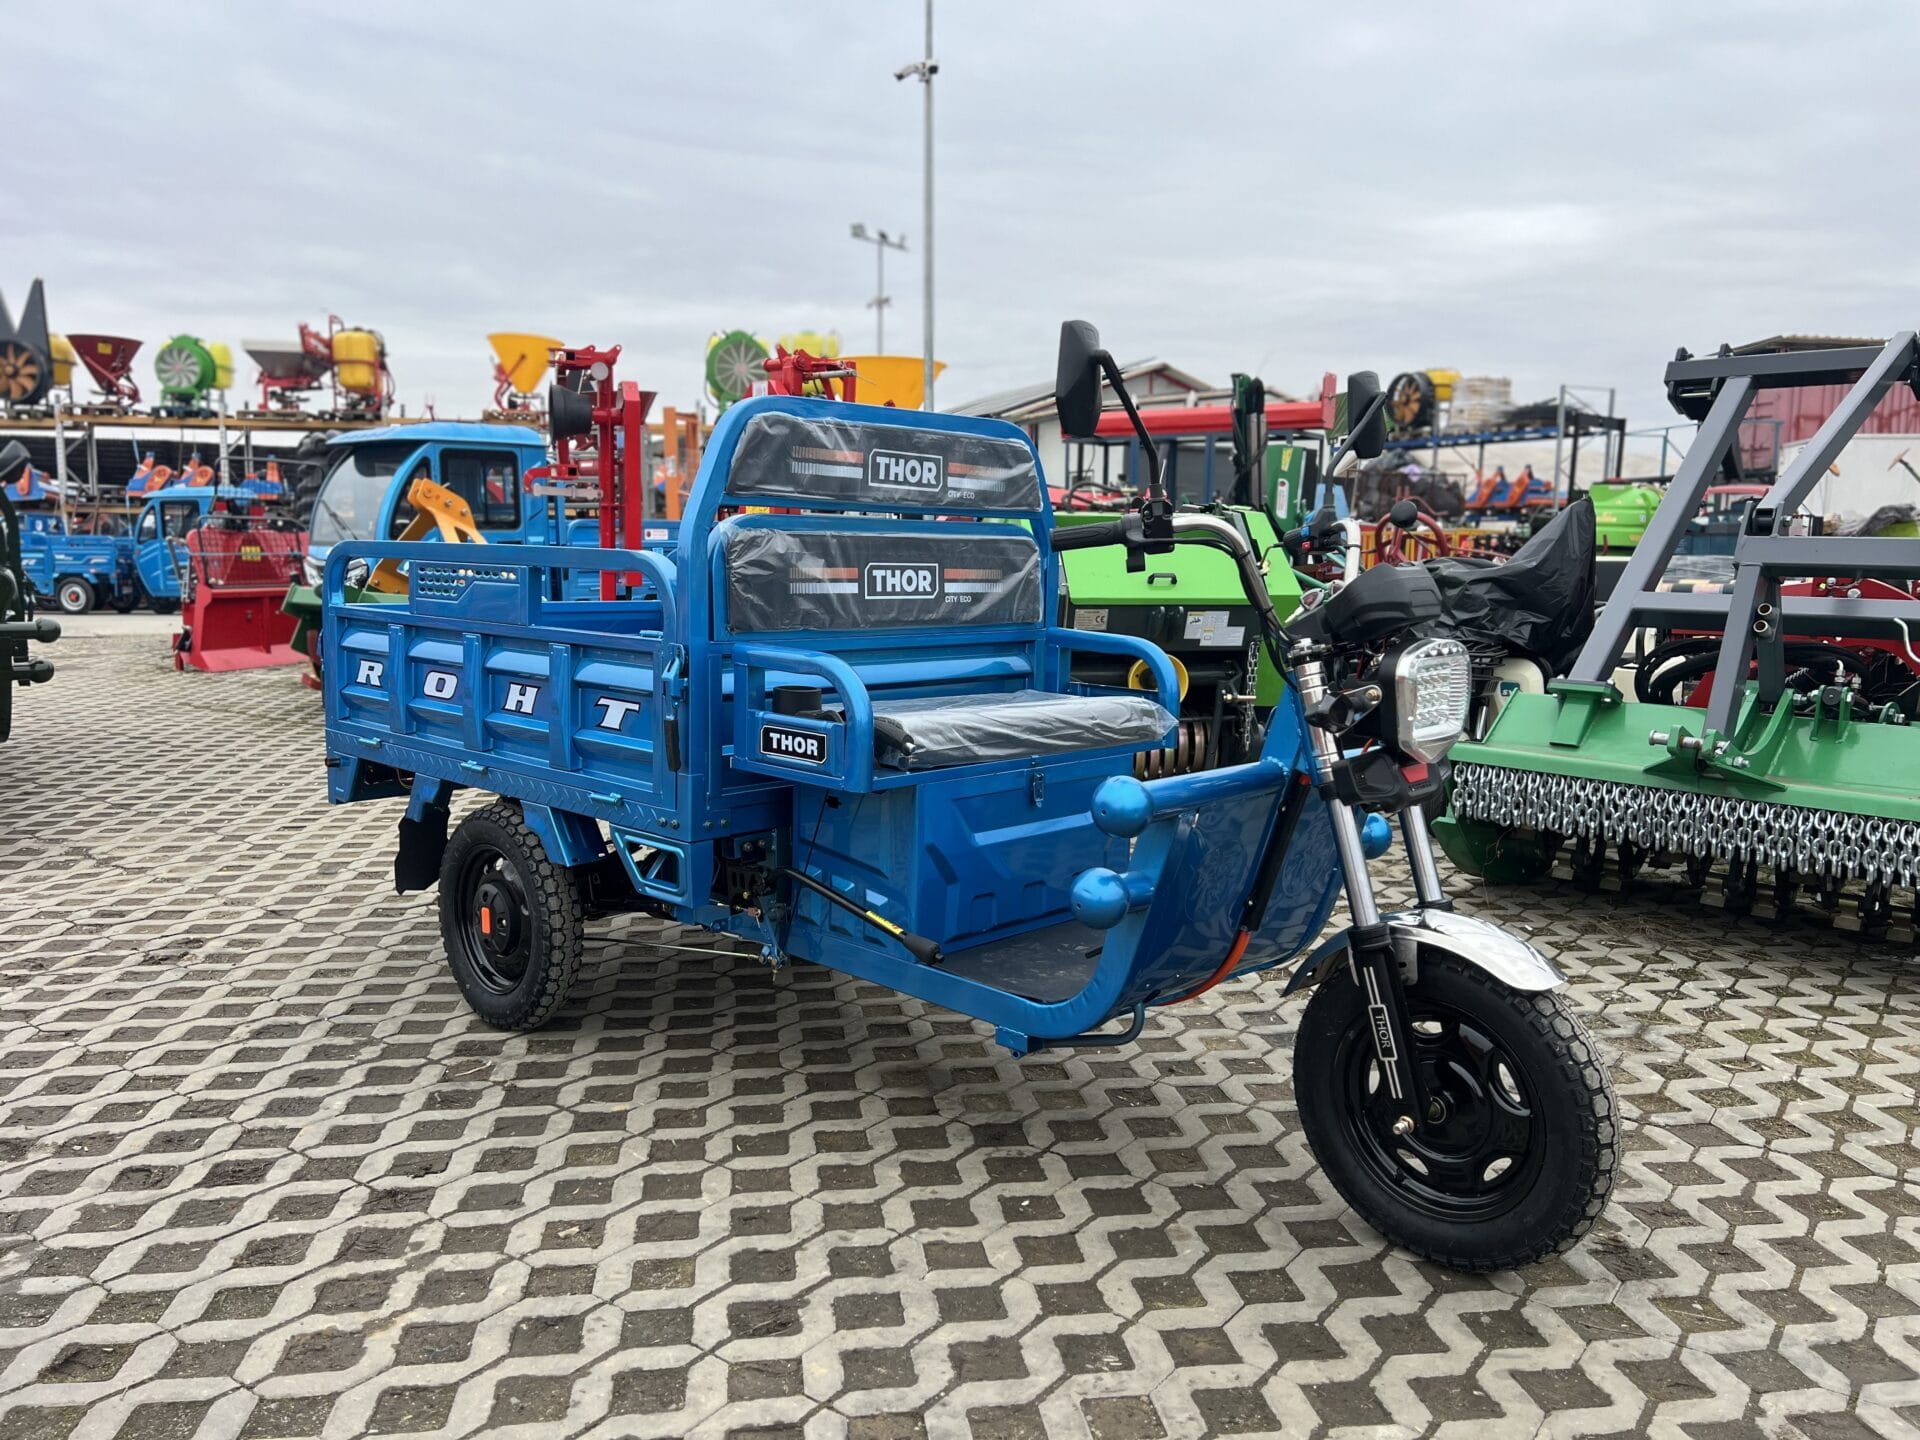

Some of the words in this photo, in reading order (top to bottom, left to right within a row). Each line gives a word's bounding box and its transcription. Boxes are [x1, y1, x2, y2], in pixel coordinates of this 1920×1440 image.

[876, 456, 937, 485] THOR
[963, 492, 975, 500] ECO
[872, 569, 932, 593] THOR
[945, 595, 957, 603] CITY
[960, 595, 972, 603] ECO
[769, 732, 818, 757] THOR
[1375, 1013, 1391, 1049] THOR
